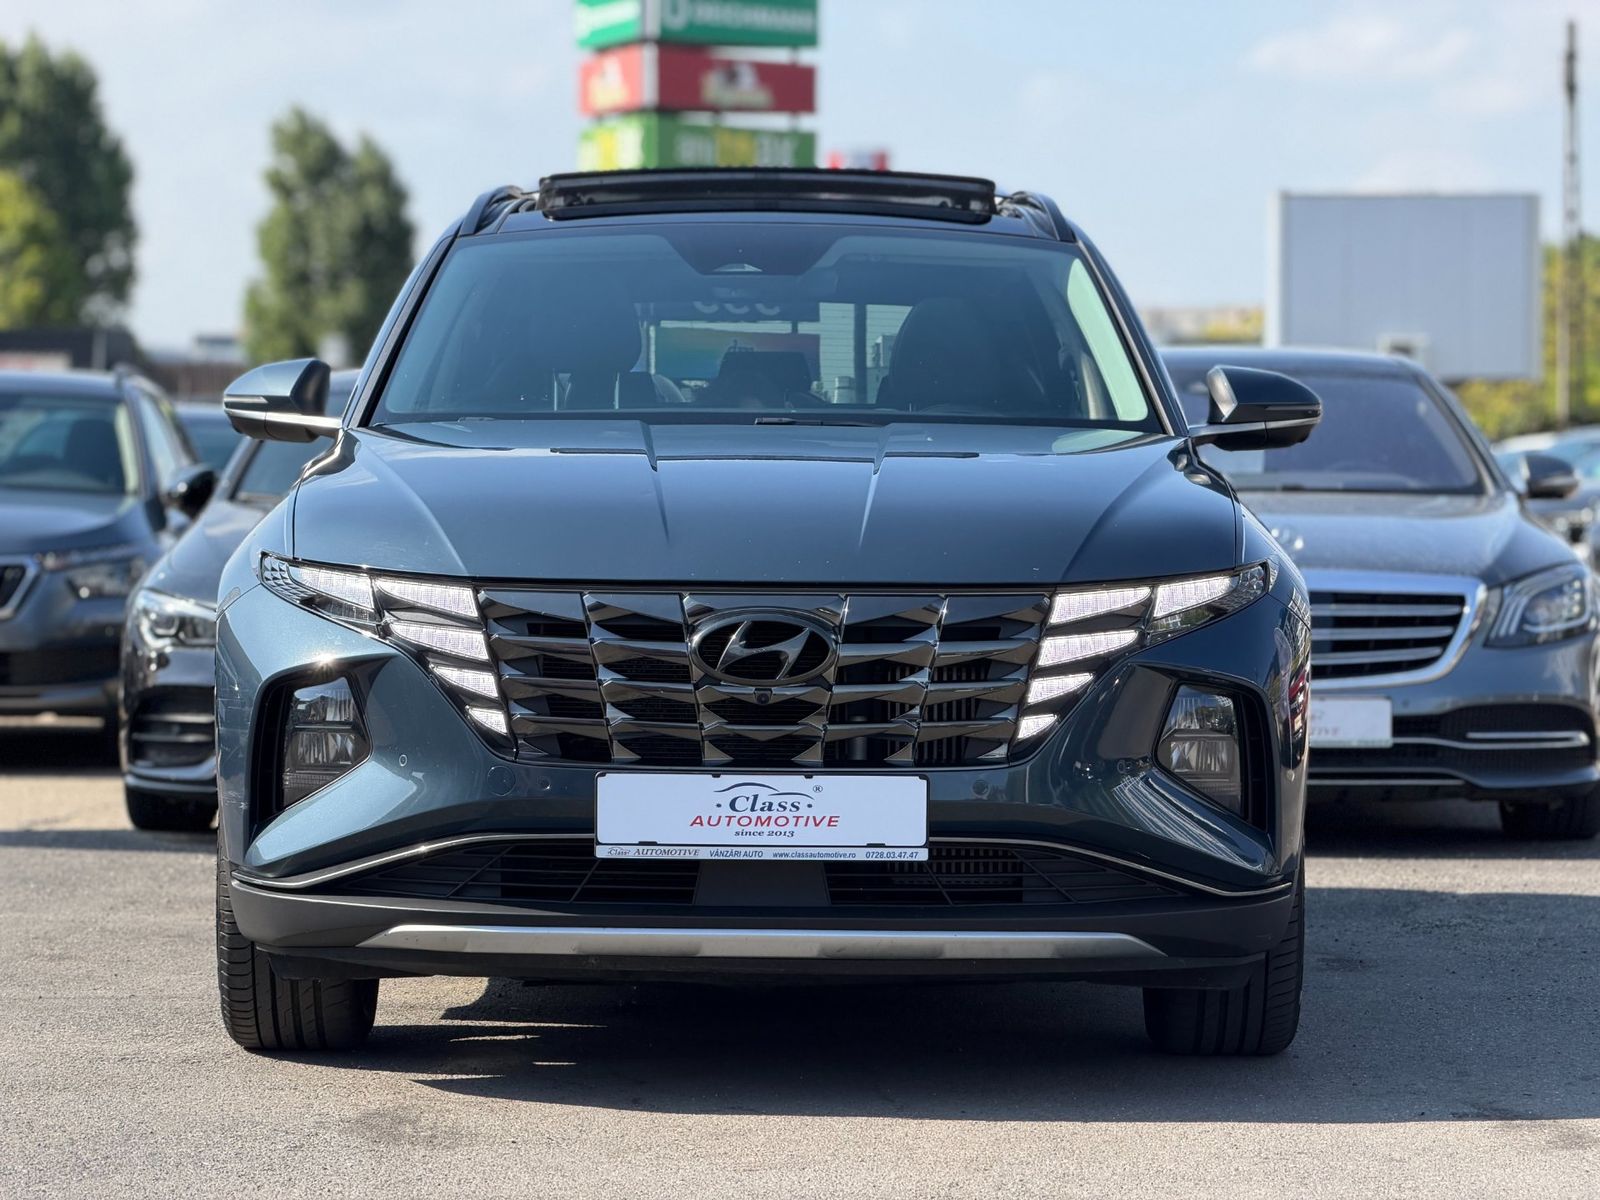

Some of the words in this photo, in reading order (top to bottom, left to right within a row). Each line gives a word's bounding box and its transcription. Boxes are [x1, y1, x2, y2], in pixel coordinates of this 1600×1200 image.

[729, 794, 801, 812] Class
[689, 815, 841, 827] AUTOMOTIVE
[734, 828, 765, 837] since
[766, 830, 795, 838] 2013
[633, 848, 701, 856] AUTOMOTIVE
[709, 849, 741, 858] VÂNZĂRI
[743, 850, 764, 858] AUTO
[772, 850, 857, 859] www.classautomotive.ro
[865, 851, 919, 859] 0728.03.47.47
